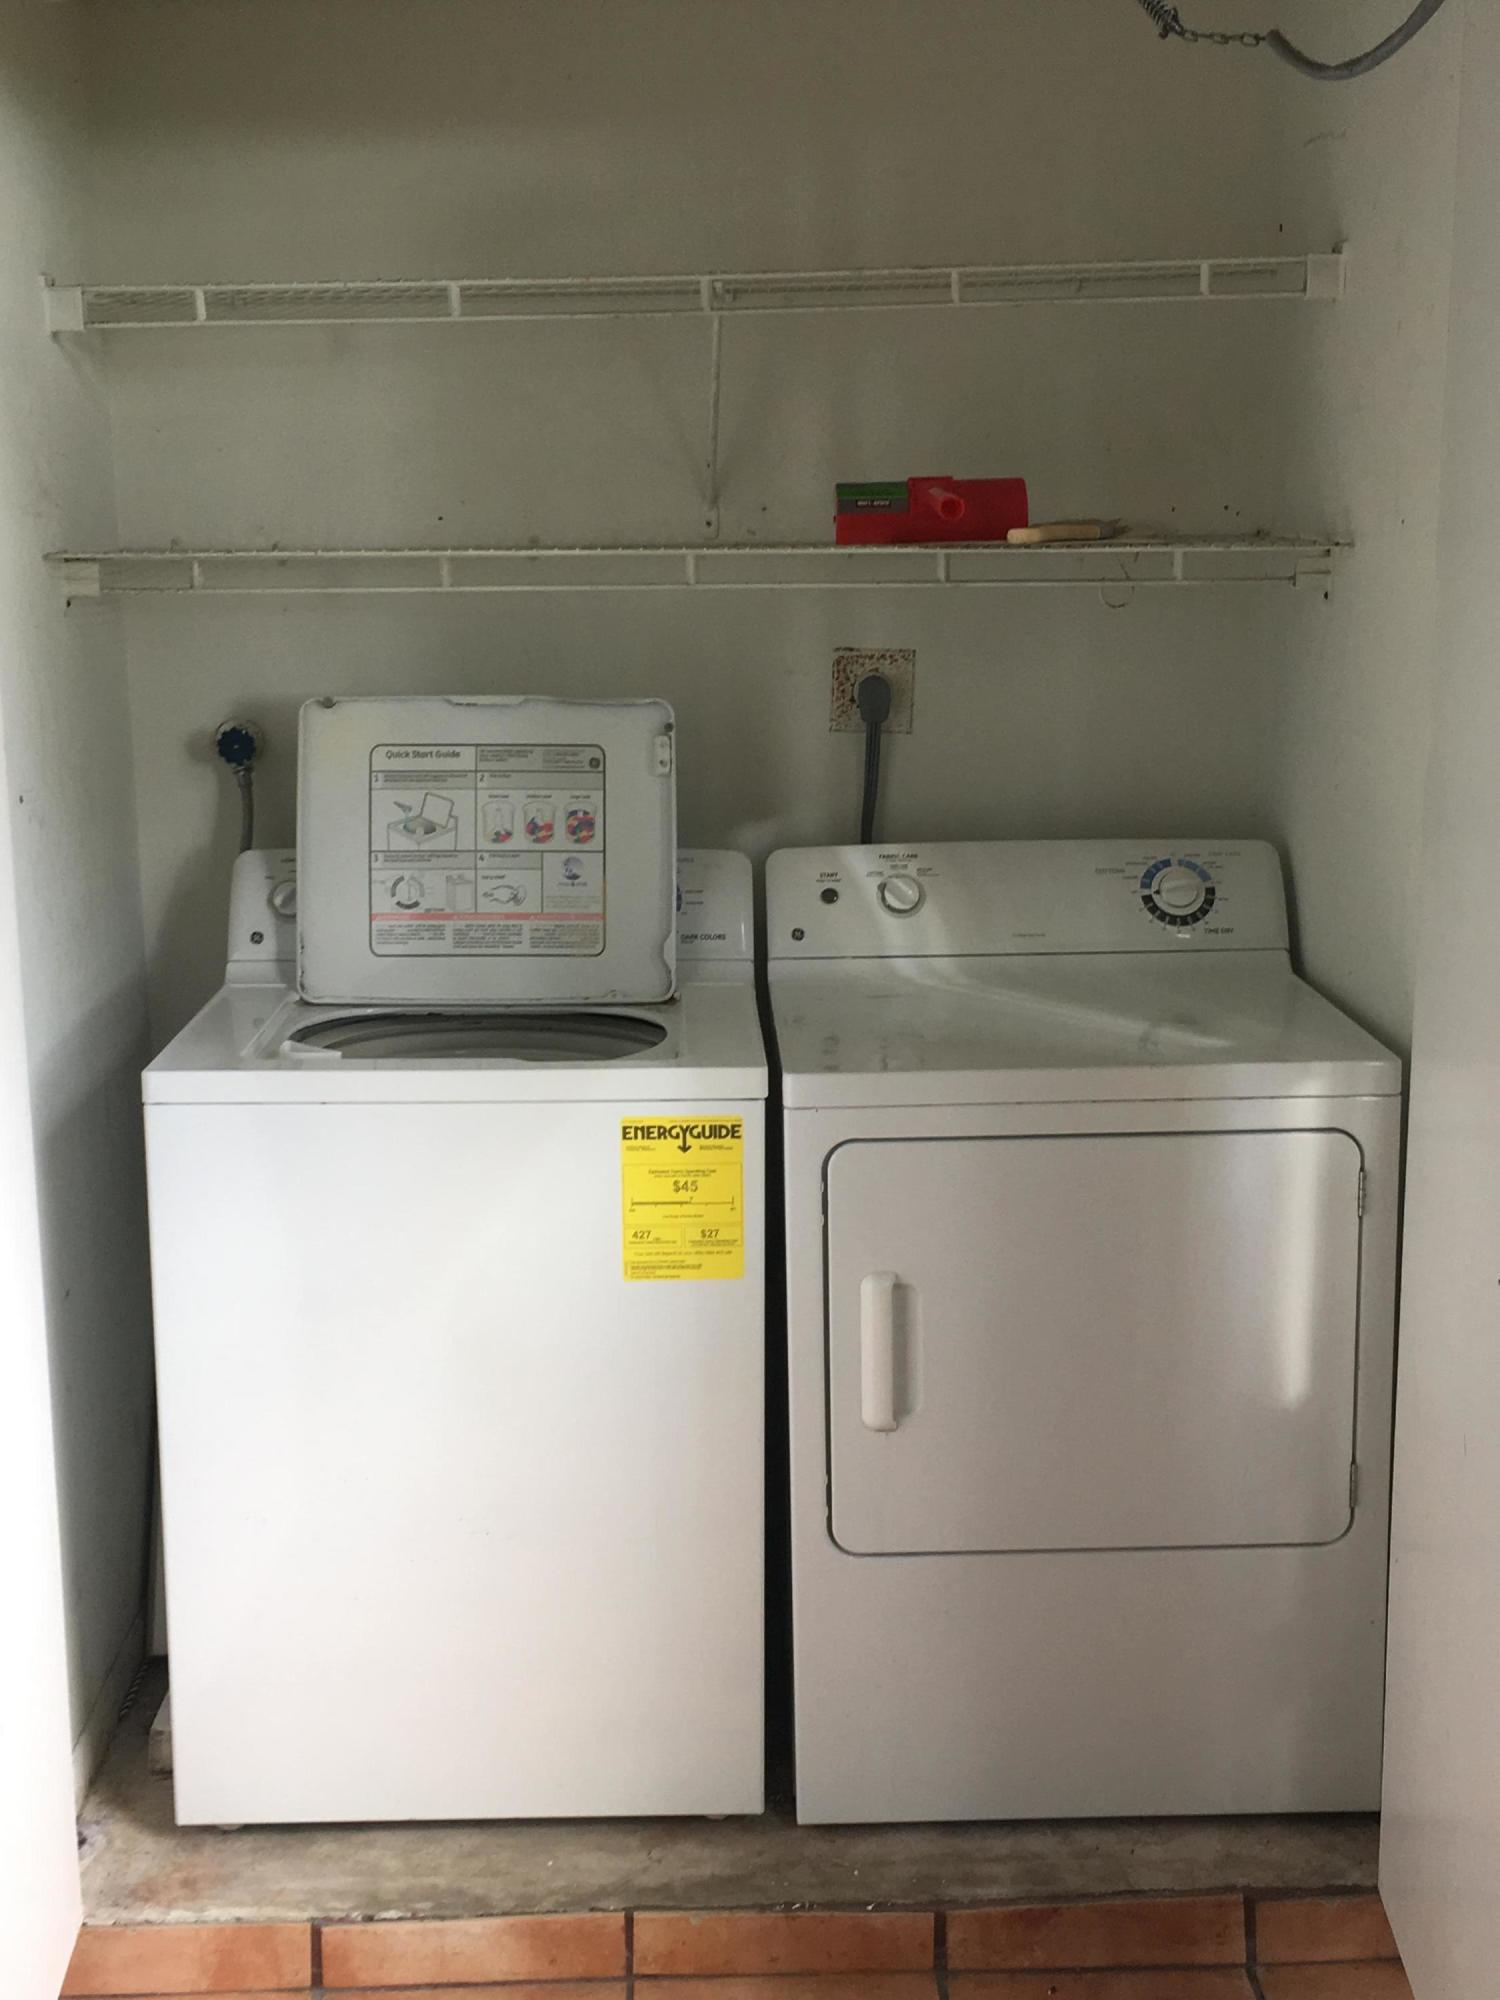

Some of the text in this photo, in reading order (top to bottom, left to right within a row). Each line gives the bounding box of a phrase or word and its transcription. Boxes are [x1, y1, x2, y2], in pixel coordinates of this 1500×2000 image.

[385, 749, 461, 760] Quick Start Guide
[622, 1124, 742, 1141] ENERGYGUIDE
[672, 1179, 699, 1193] $45
[631, 1230, 652, 1240] 427
[700, 1228, 720, 1239] $27
